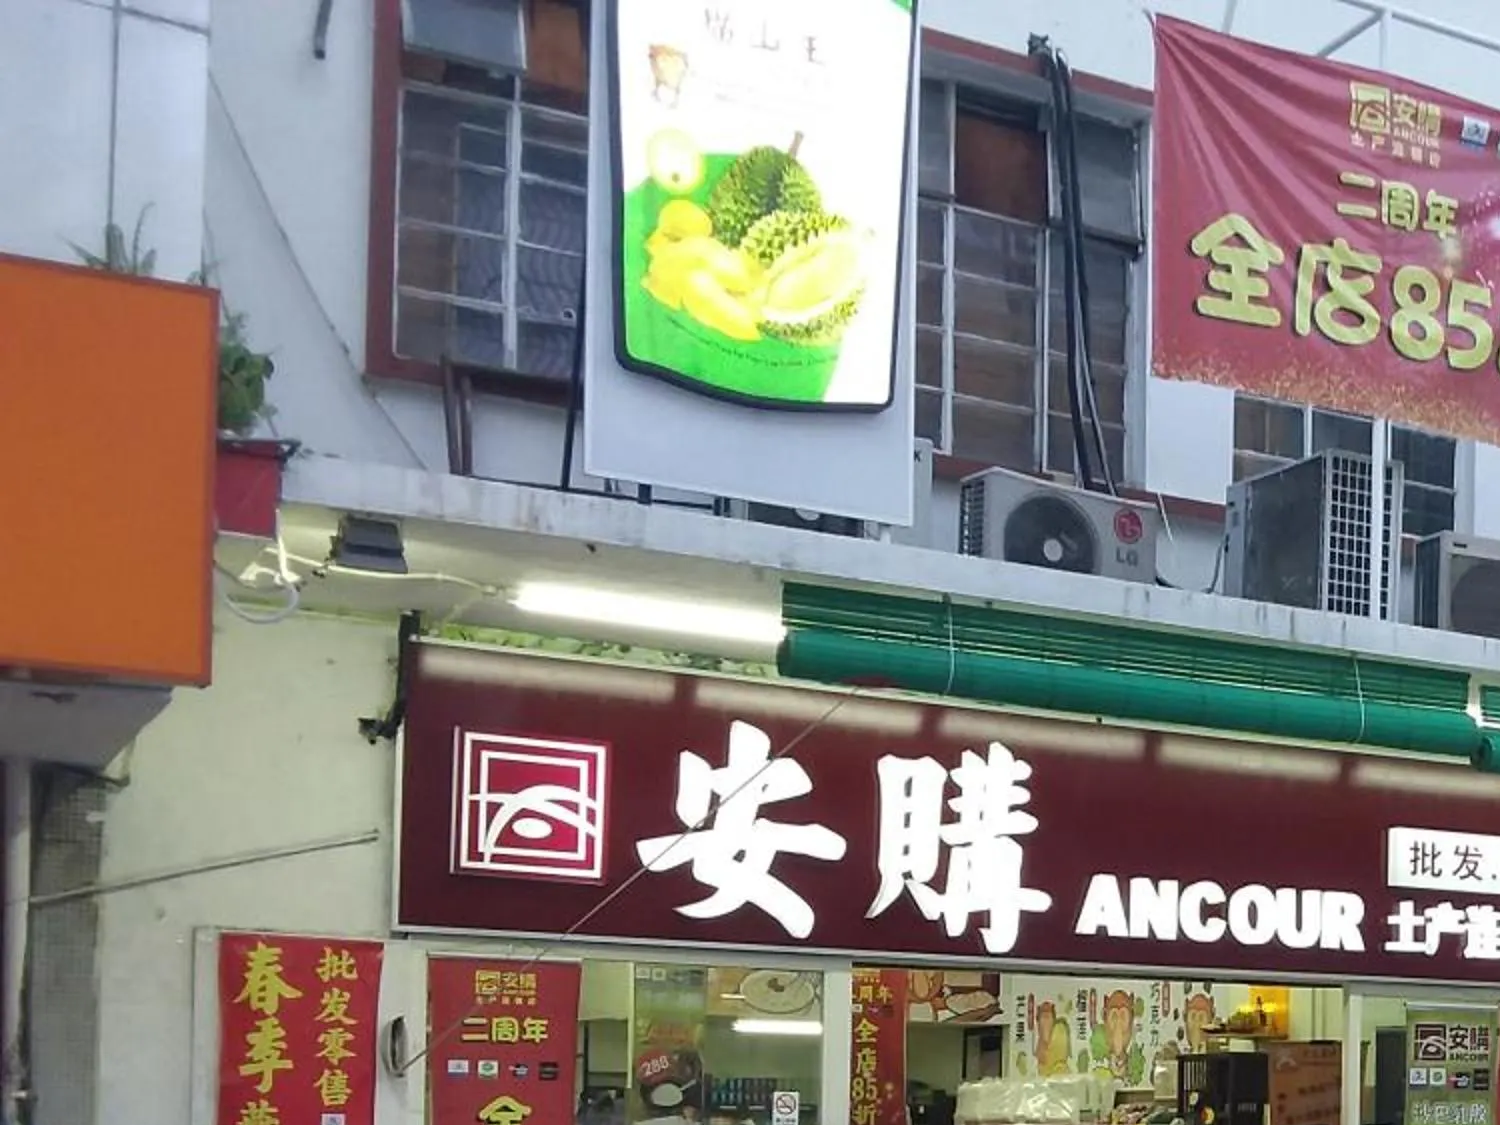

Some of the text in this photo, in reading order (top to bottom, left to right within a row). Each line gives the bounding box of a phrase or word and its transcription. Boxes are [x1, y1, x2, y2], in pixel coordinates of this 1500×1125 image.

[1336, 170, 1460, 241] 二周年
[1075, 873, 1365, 952] ANCOUR
[313, 946, 358, 1107] 批发零售
[851, 985, 893, 1004] 周年
[461, 1016, 549, 1045] 二周年
